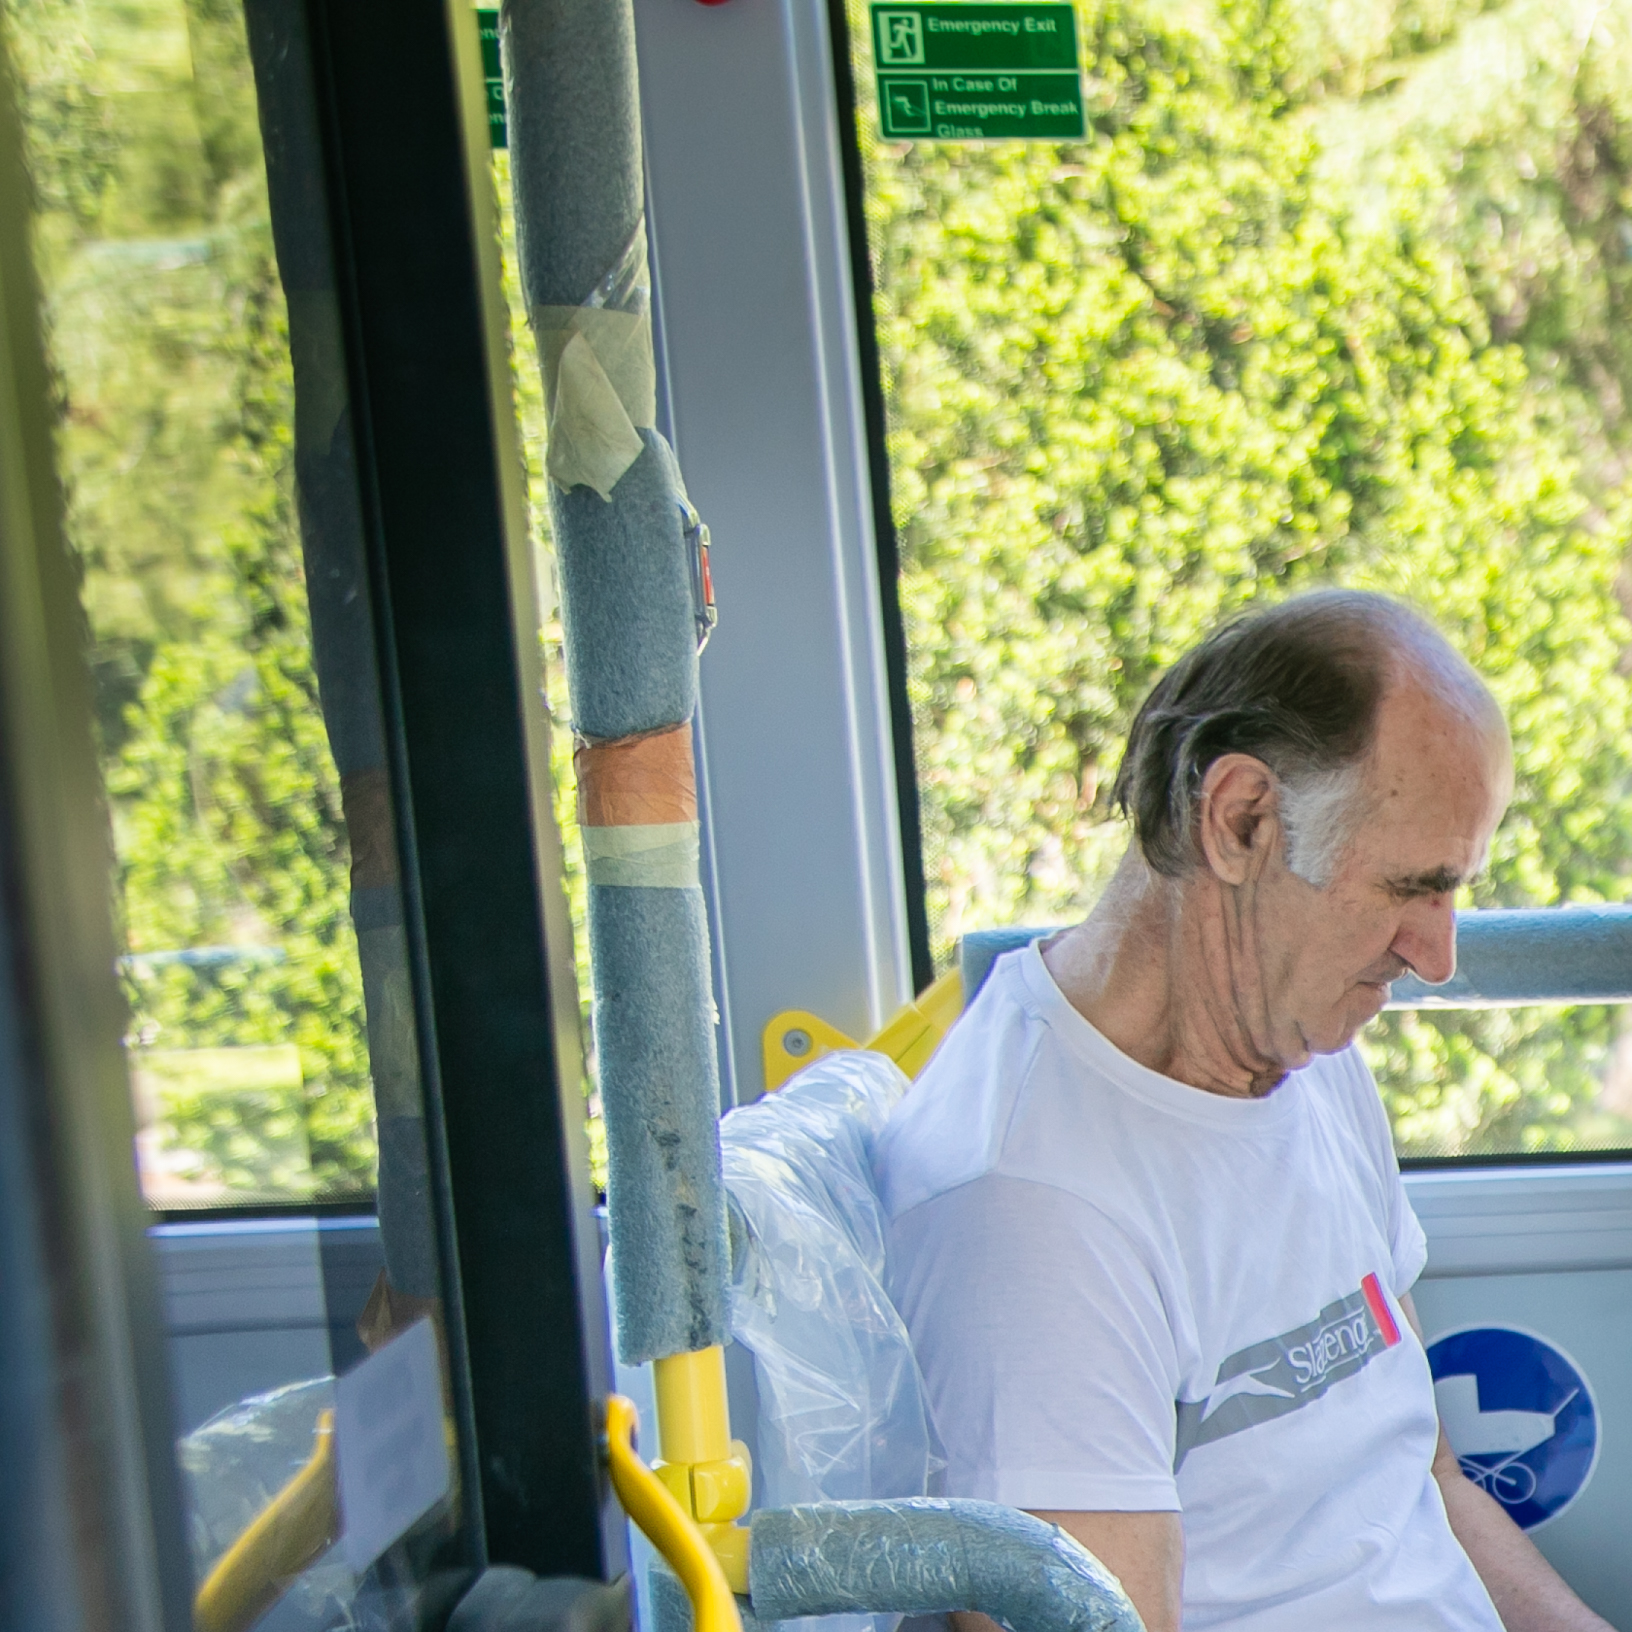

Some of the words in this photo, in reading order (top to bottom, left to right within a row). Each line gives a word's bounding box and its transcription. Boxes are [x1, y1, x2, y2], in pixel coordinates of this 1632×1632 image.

[927, 17, 1020, 35] Emergency
[1024, 17, 1057, 32] Exit
[932, 77, 949, 91] In
[953, 77, 993, 92] Case
[998, 77, 1018, 92] Of
[934, 101, 1026, 118] Emergency
[1031, 100, 1079, 115] Break
[937, 124, 985, 138] Glass
